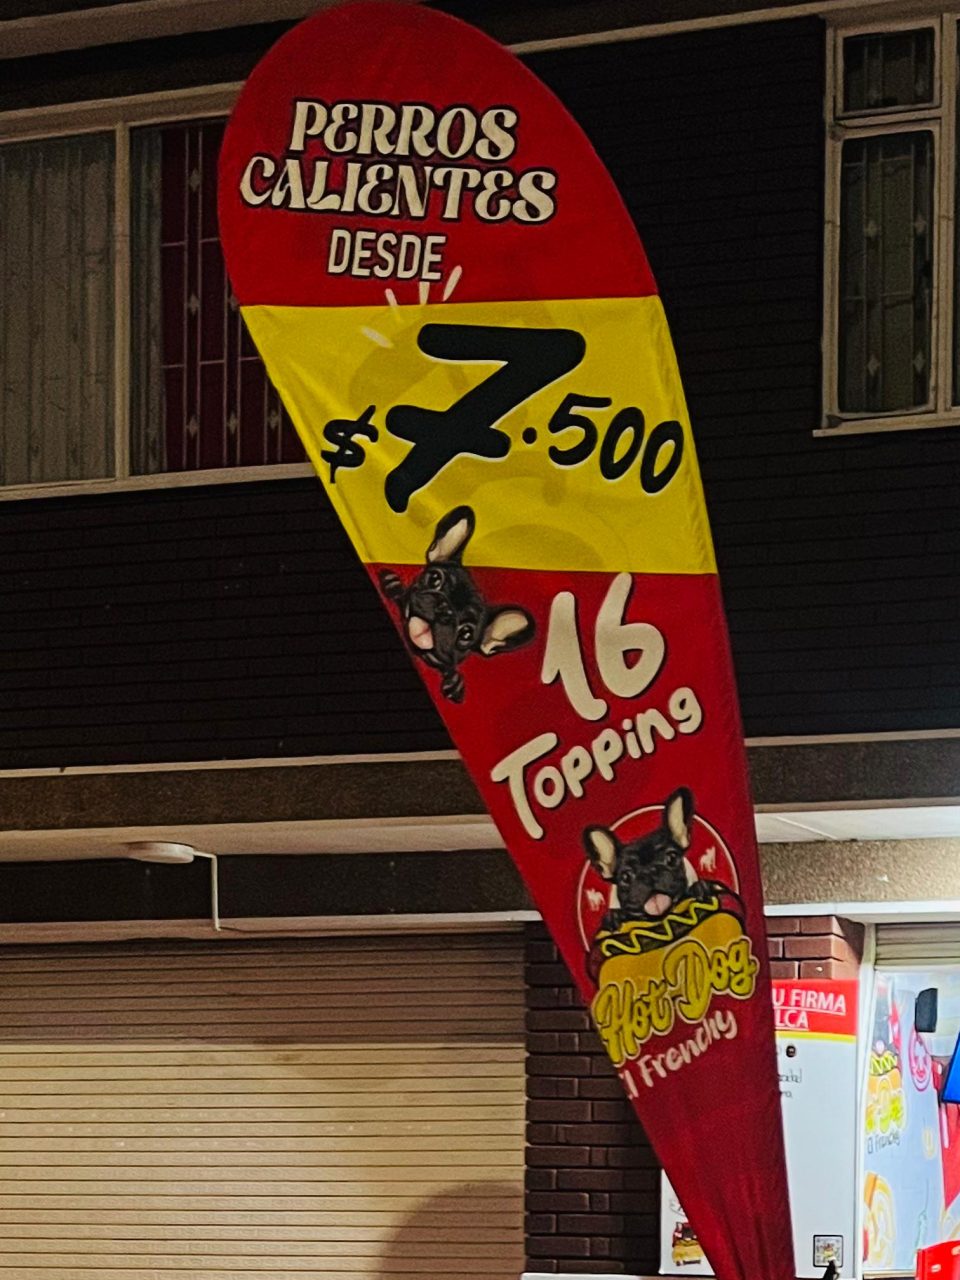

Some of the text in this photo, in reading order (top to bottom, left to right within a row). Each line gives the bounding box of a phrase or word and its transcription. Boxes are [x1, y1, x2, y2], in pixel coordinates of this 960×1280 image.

[289, 100, 518, 160] PERROS
[239, 156, 557, 222] CALIENTES
[327, 228, 446, 280] DESDE
[541, 573, 665, 720] 16
[491, 686, 702, 839] Topping
[593, 936, 759, 1066] Hot Dog
[772, 988, 846, 1014] U FIRMA
[775, 1010, 809, 1029] LCA
[619, 1010, 738, 1099] l Frenchy
